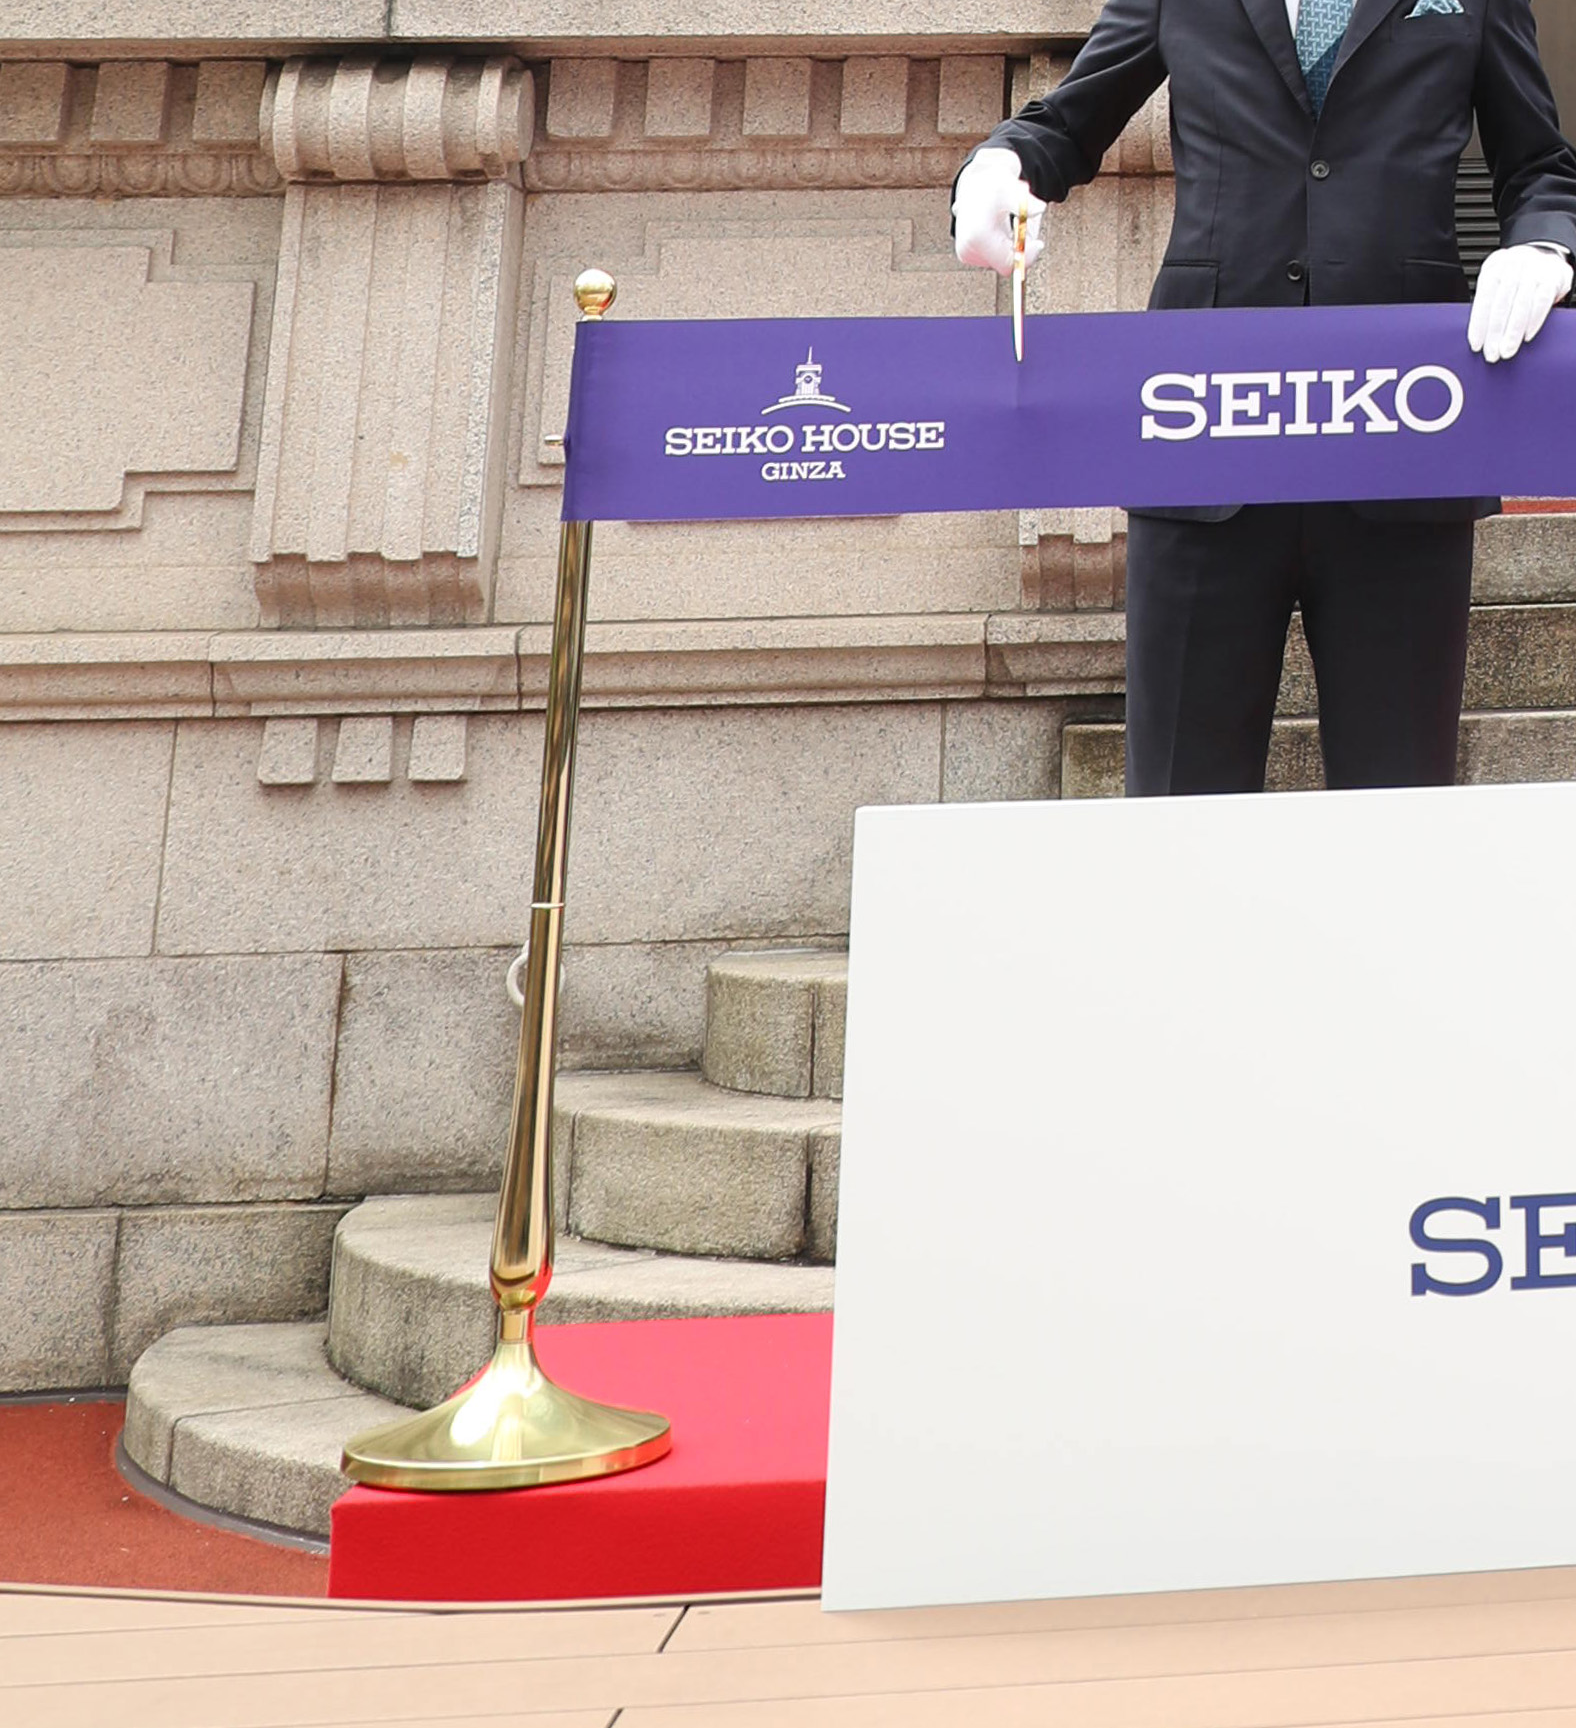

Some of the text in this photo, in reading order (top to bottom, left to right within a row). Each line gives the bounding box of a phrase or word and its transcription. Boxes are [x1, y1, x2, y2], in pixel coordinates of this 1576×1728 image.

[1140, 364, 1464, 441] SEIKO
[664, 421, 945, 456] SEIKO HOUSE
[760, 460, 847, 481] GINZA
